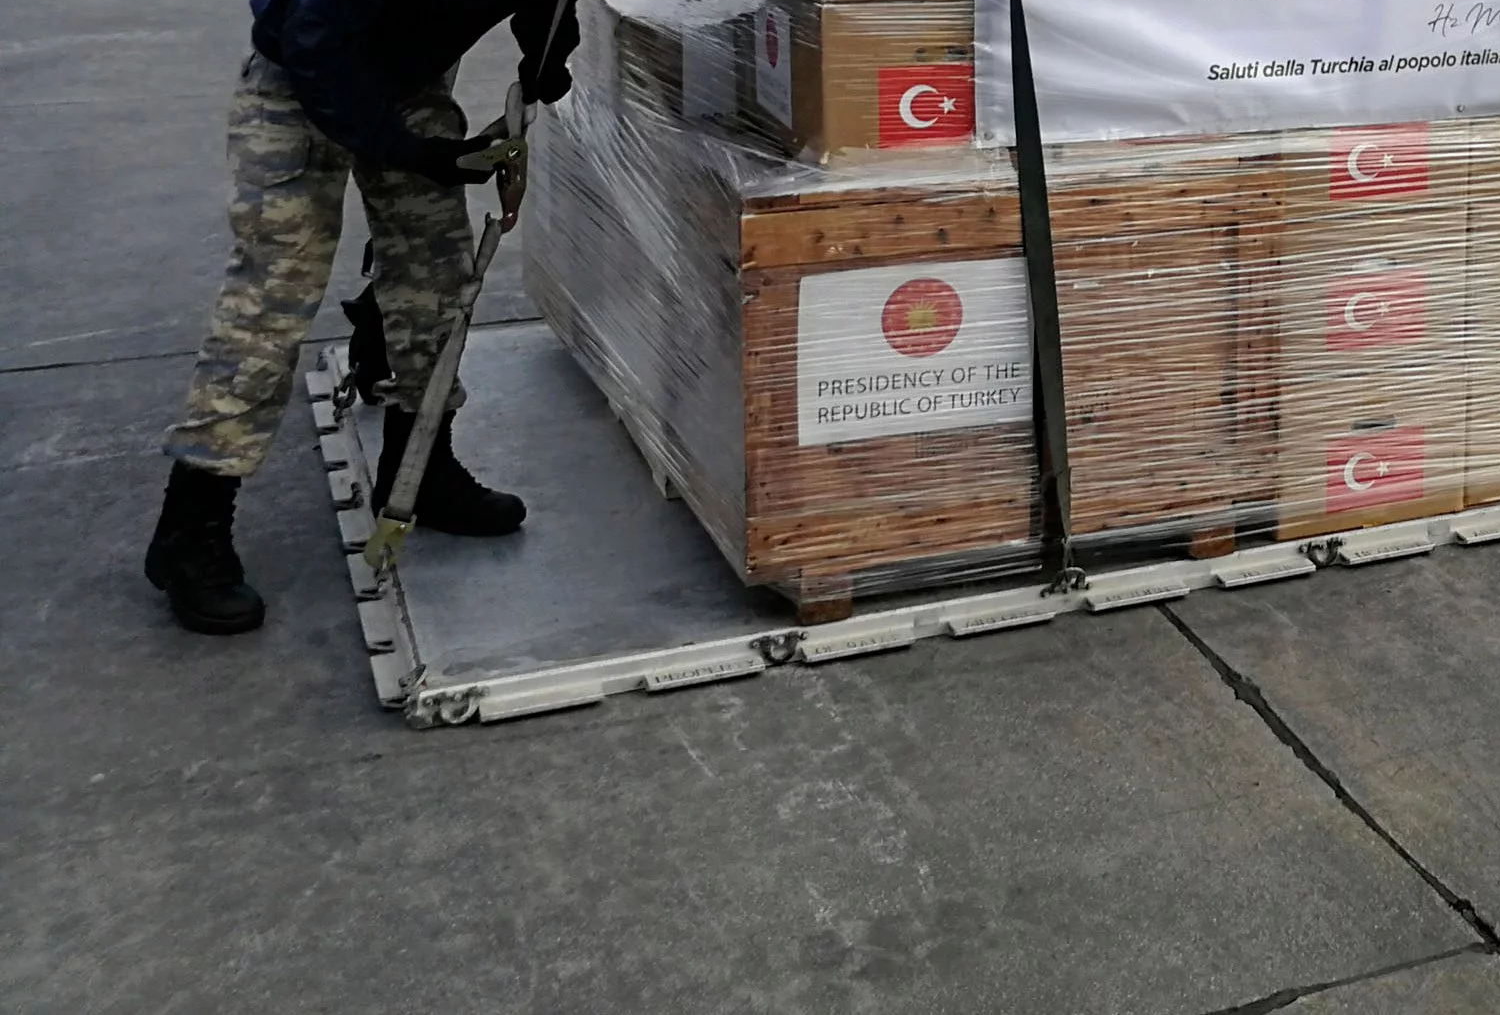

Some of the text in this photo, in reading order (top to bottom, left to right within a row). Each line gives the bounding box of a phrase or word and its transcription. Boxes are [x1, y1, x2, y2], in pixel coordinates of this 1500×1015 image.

[1207, 61, 1258, 80] Saluti
[1262, 59, 1304, 78] dalla
[1310, 55, 1375, 75] Turchia
[1378, 54, 1395, 72] al
[1395, 51, 1456, 72] popolo
[818, 362, 1022, 397] PRESIDENCY OF THE
[818, 388, 1022, 424] REPUBLIC OF TURKEY
